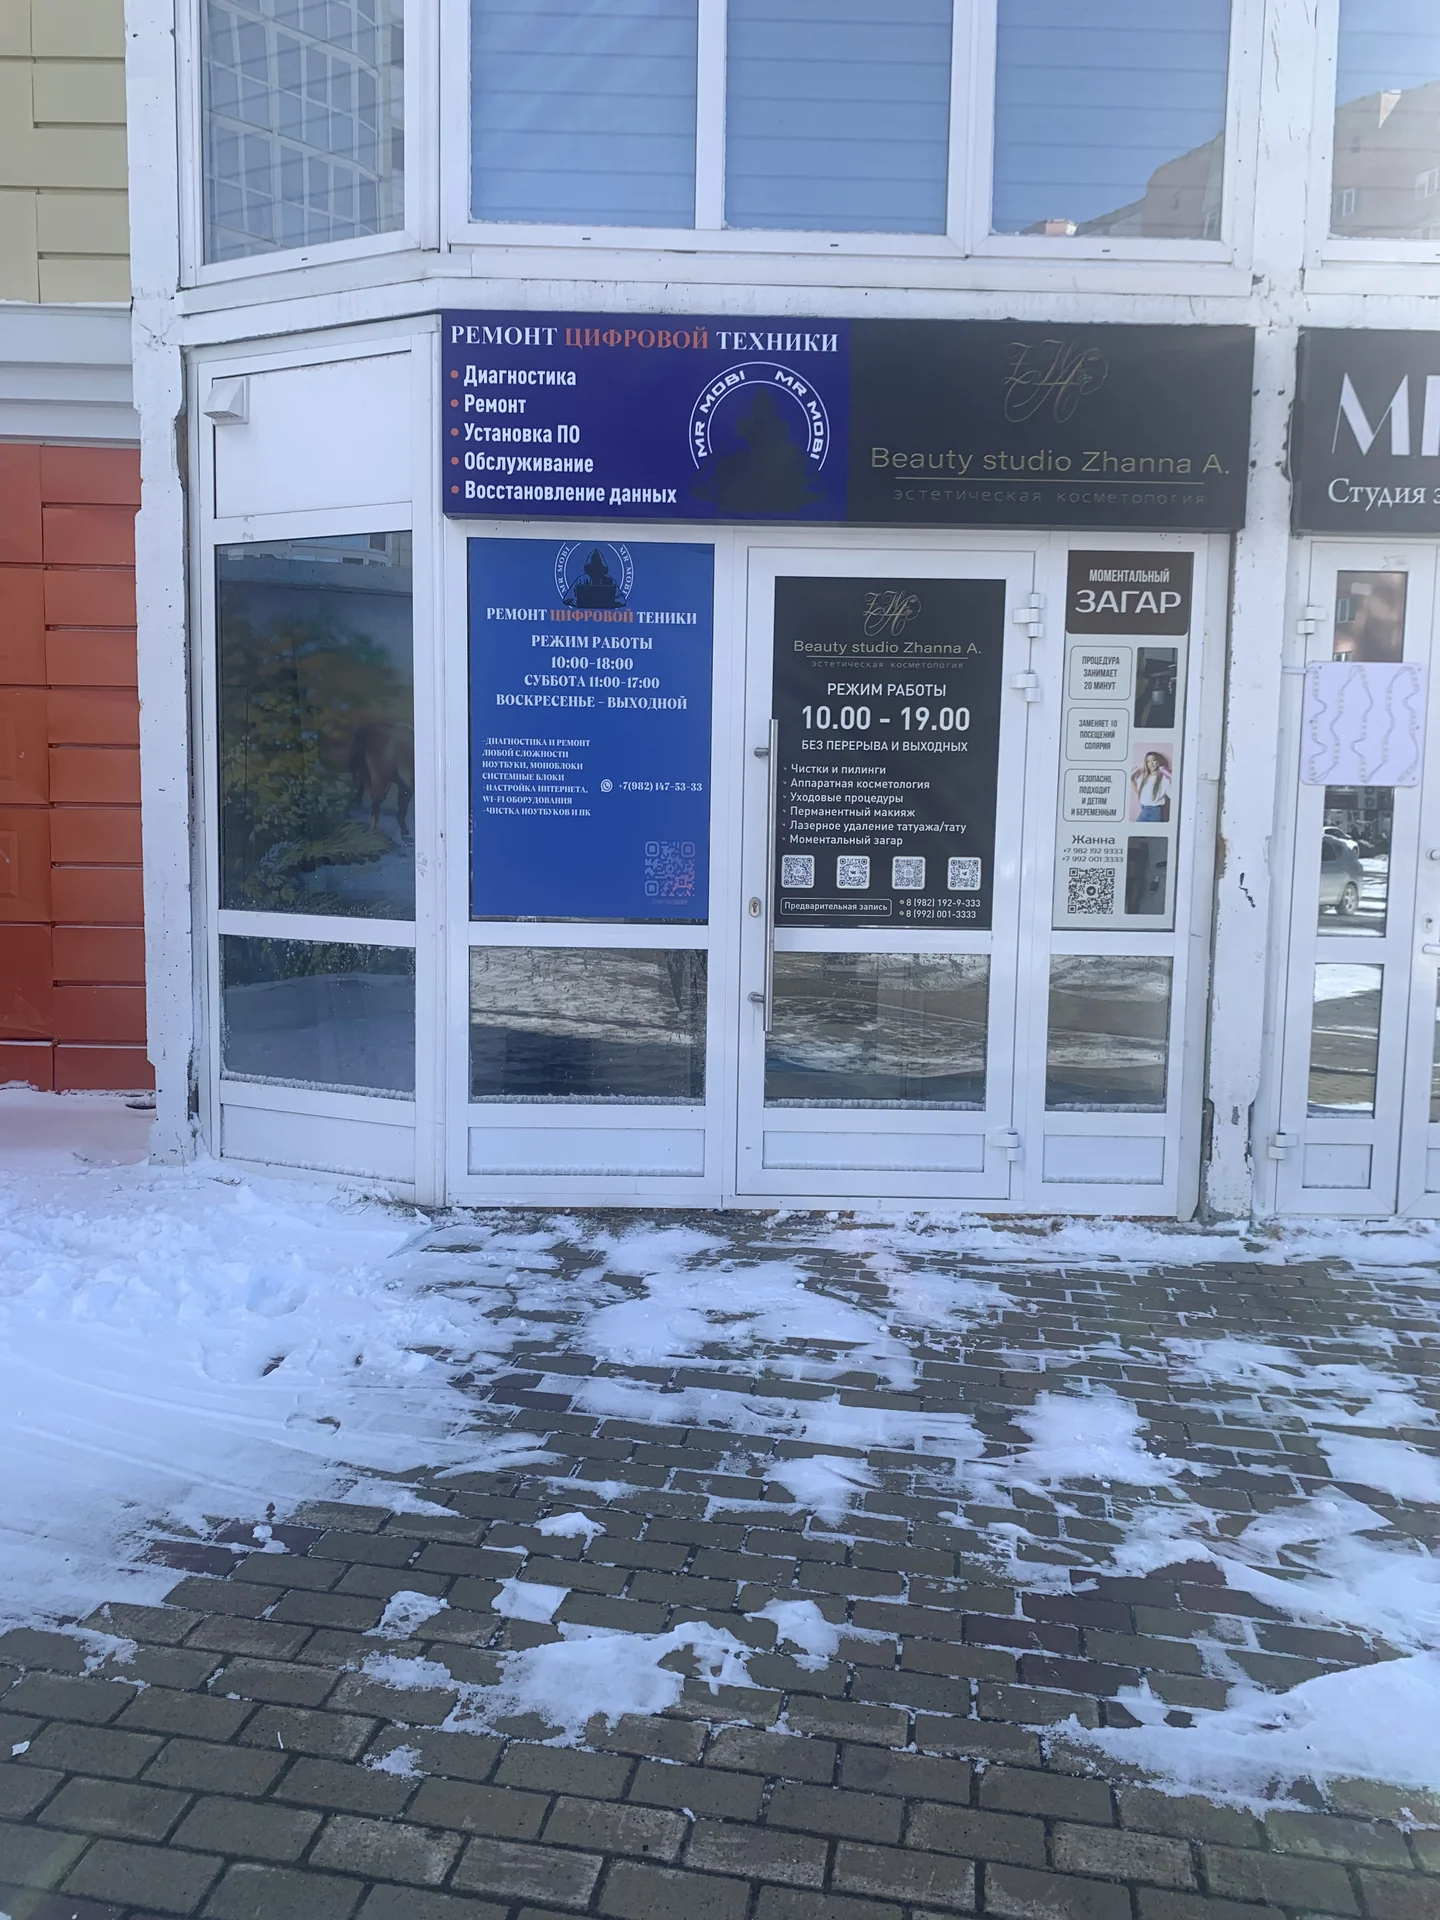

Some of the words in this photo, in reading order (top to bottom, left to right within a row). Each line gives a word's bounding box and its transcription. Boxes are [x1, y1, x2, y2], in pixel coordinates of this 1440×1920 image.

[450, 325, 558, 346] РЕМОНТ
[565, 326, 709, 350] ЦИФРОВОЙ
[716, 331, 839, 352] ТЕХНИКИ
[464, 365, 577, 386] Диагностика
[700, 370, 745, 414] MOBI
[464, 394, 526, 414] Ремонт
[775, 370, 808, 397] MR
[807, 400, 824, 460] MOBI
[464, 423, 552, 444] Установка
[557, 425, 580, 444] ПО
[695, 421, 708, 458] MR
[464, 452, 594, 473] Обслуживание
[871, 447, 973, 475] Beauty
[983, 449, 1072, 472] studio
[1082, 452, 1192, 474] Zhanna
[1202, 455, 1230, 474] A.
[465, 481, 605, 502] Восстановление
[609, 486, 677, 505] данных
[893, 488, 1041, 502] эстетическая
[1057, 489, 1205, 505] косметология
[1328, 478, 1427, 512] Студия
[1089, 568, 1170, 582] МОМЕНТАЛЬНЫЙ
[1075, 590, 1182, 614] ЗАГАР
[487, 608, 547, 621] РЕМОНТ
[550, 608, 634, 623] ЦИФРОВОЙ
[637, 611, 697, 625] ТЕНИКИ
[531, 635, 589, 648] РЕЖИМ
[592, 636, 653, 650] РАБОТЫ
[794, 641, 848, 655] Beauty
[852, 642, 899, 653] studio
[903, 642, 961, 654] Zhanna
[966, 643, 982, 654] A.
[811, 660, 884, 668] эстетическая
[891, 661, 963, 669] косметология
[1082, 656, 1120, 665] ПРОЦЕДУРА
[1084, 669, 1118, 678] ЗАНИМАЕТ
[524, 674, 585, 687] СУББОТА
[1084, 682, 1092, 690] 20
[1094, 682, 1116, 690] МИНУТ
[827, 683, 882, 696] РЕЖИМ
[887, 684, 946, 697] РАБОТЫ
[496, 694, 595, 708] ВОСКРЕСЕНЬЕ
[607, 696, 687, 711] ВЫХОДНОЙ
[802, 706, 871, 730] 10.00
[901, 707, 970, 731] 19.00
[1079, 719, 1109, 728] ЗАМЕНЯЕТ
[1111, 720, 1118, 728] 10
[1080, 730, 1116, 739] ПОСЕЩЕНИЙ
[557, 739, 590, 747] РЕМОНТ
[802, 740, 823, 750] БЕЗ
[826, 740, 888, 751] ПЕРЕРЫВА
[892, 741, 899, 751] И
[903, 741, 968, 753] ВЫХОДНЫХ
[1085, 742, 1111, 750] СОЛЯРИЯ
[482, 748, 514, 757] ЛЮБОЙ
[515, 750, 569, 758] СЛОЖНОСТИ
[482, 761, 529, 769] НОУТБУКИ,
[530, 762, 583, 770] МОНОБЛОКИ
[791, 764, 829, 774] Чистки
[832, 766, 838, 774] и
[841, 766, 886, 775] пилинги
[482, 772, 535, 781] СИСТЕМНЫЕ
[536, 774, 564, 782] БЛОКИ
[1078, 775, 1113, 784] БЕЗОПАСНО,
[618, 781, 653, 792] +7(982)
[655, 782, 703, 792] 147-53-33
[790, 778, 853, 790] Аппаратная
[856, 781, 930, 790] косметология
[1079, 786, 1111, 795] ПОДХОДИТ
[483, 795, 505, 803] WI-FI
[506, 796, 572, 805] ОБОРУДОВАНИЯ
[790, 793, 842, 804] Уходовые
[845, 794, 904, 805] процедуры
[1081, 797, 1086, 805] И
[1087, 798, 1107, 806] ДЕТЯМ
[521, 808, 570, 816] НОУТБУКОВ
[579, 809, 592, 817] ПК
[790, 807, 871, 818] Перманентный
[874, 809, 916, 818] макияж
[1071, 808, 1075, 816] И
[1076, 809, 1117, 817] БЕРЕМЕННЫМ
[789, 821, 841, 832] Лазерное
[844, 822, 894, 833] удаление
[897, 822, 967, 834] татуажа/тату
[790, 835, 871, 845] Моментальный
[874, 836, 903, 847] загар
[1072, 835, 1116, 845] Жанна
[784, 902, 858, 911] Предварительная
[859, 903, 888, 911] запись
[906, 899, 912, 907] 8
[913, 898, 935, 907] (982)
[937, 899, 981, 908] 192-9-333
[906, 910, 912, 918] 8
[913, 910, 935, 919] (992)
[937, 910, 977, 919] 001-3333
